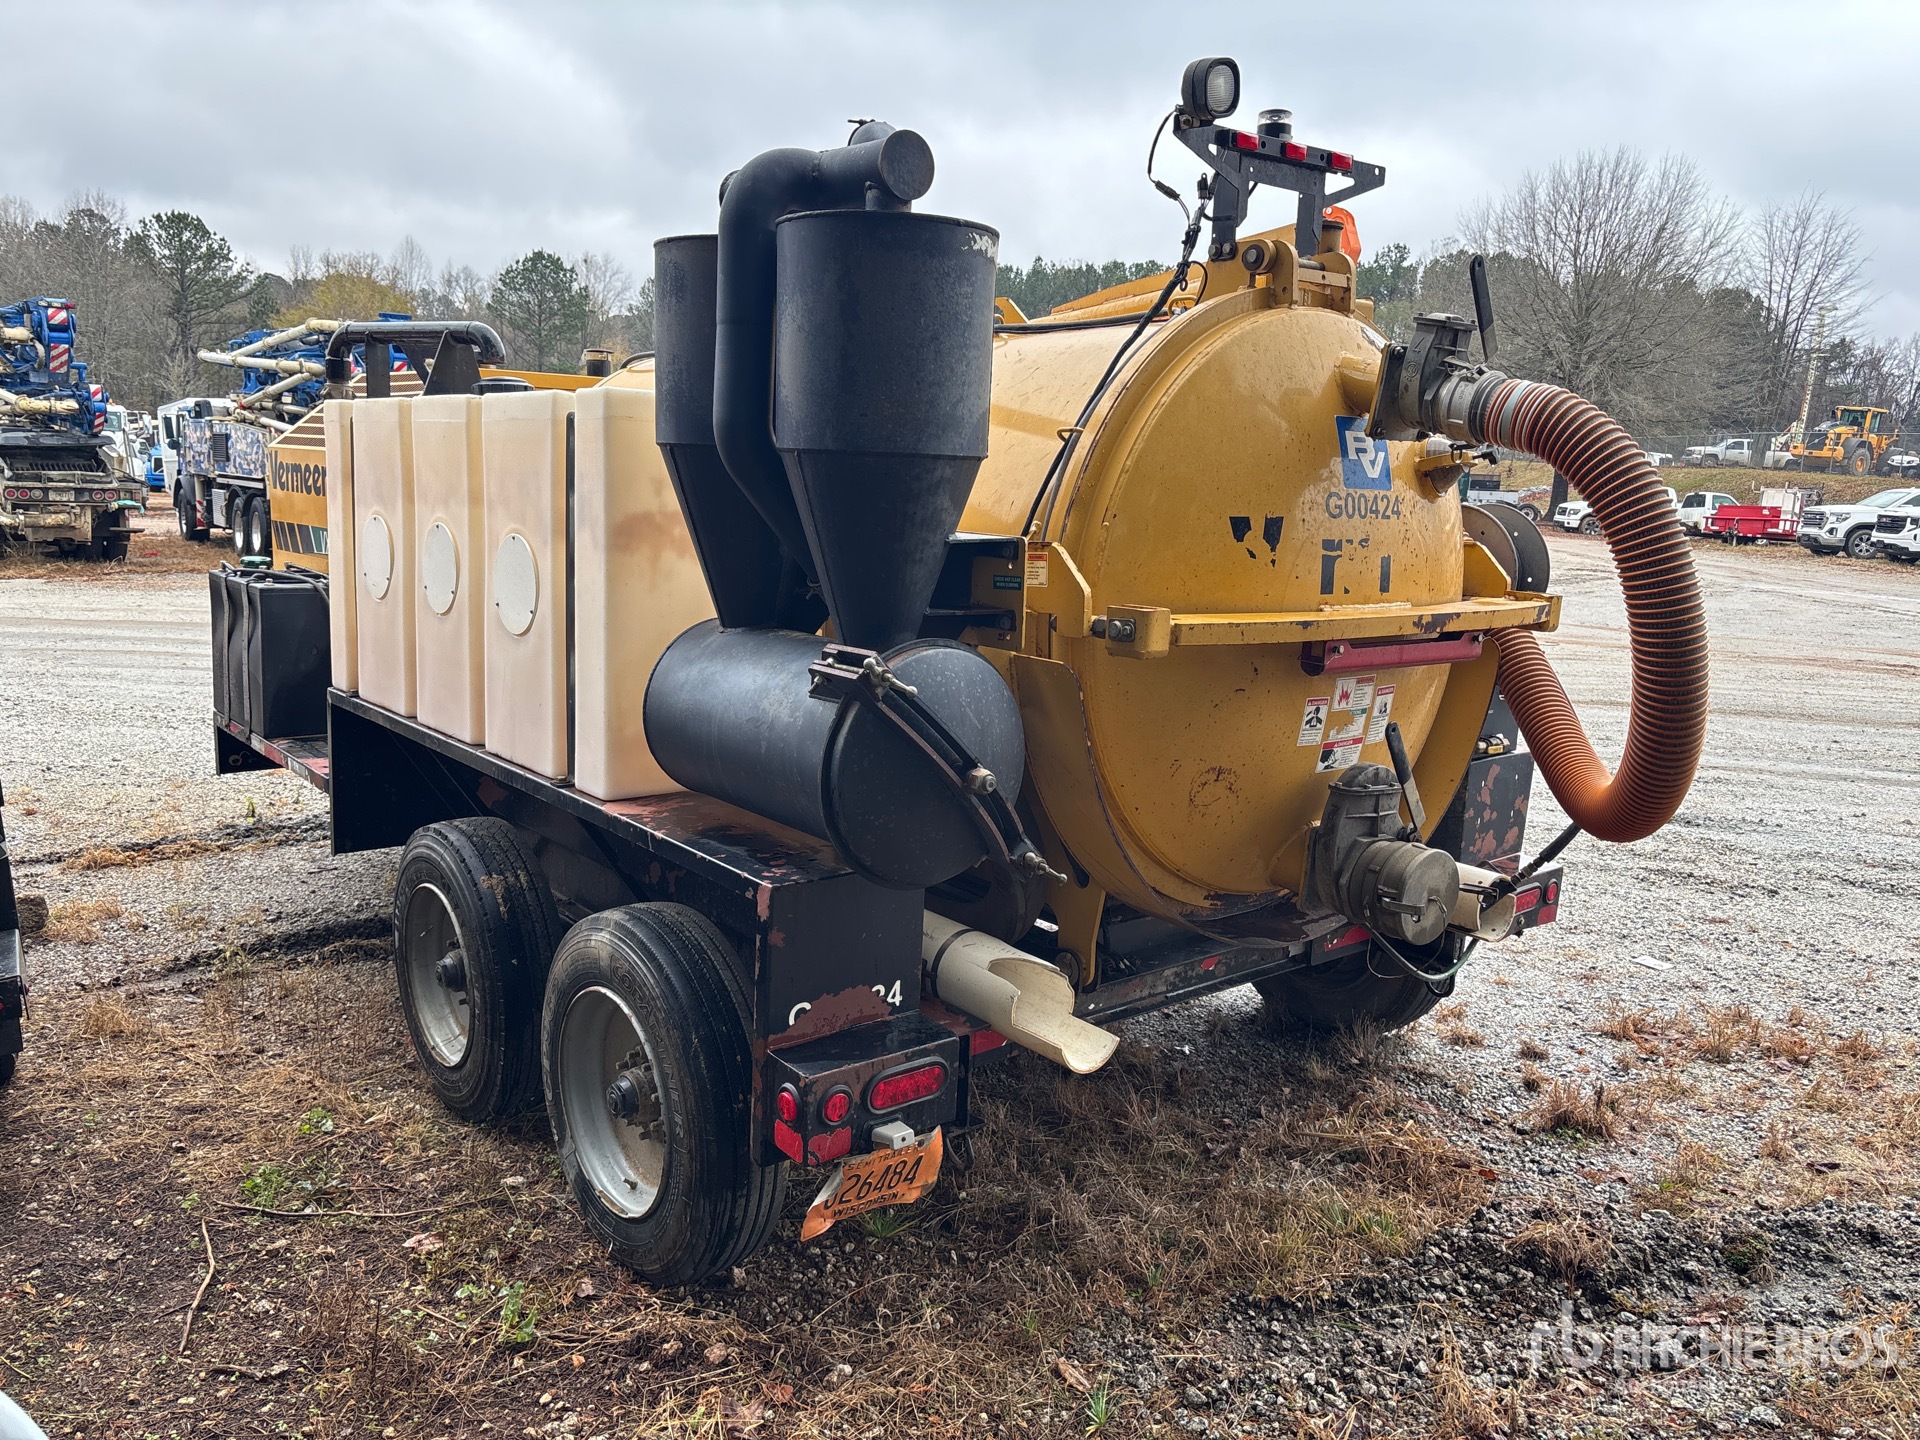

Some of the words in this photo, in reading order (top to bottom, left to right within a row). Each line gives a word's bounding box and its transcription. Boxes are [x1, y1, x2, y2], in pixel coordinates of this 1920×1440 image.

[1325, 491, 1402, 520] G00424
[846, 1159, 876, 1171] SEMI
[832, 1190, 900, 1218] WISCONSIN
